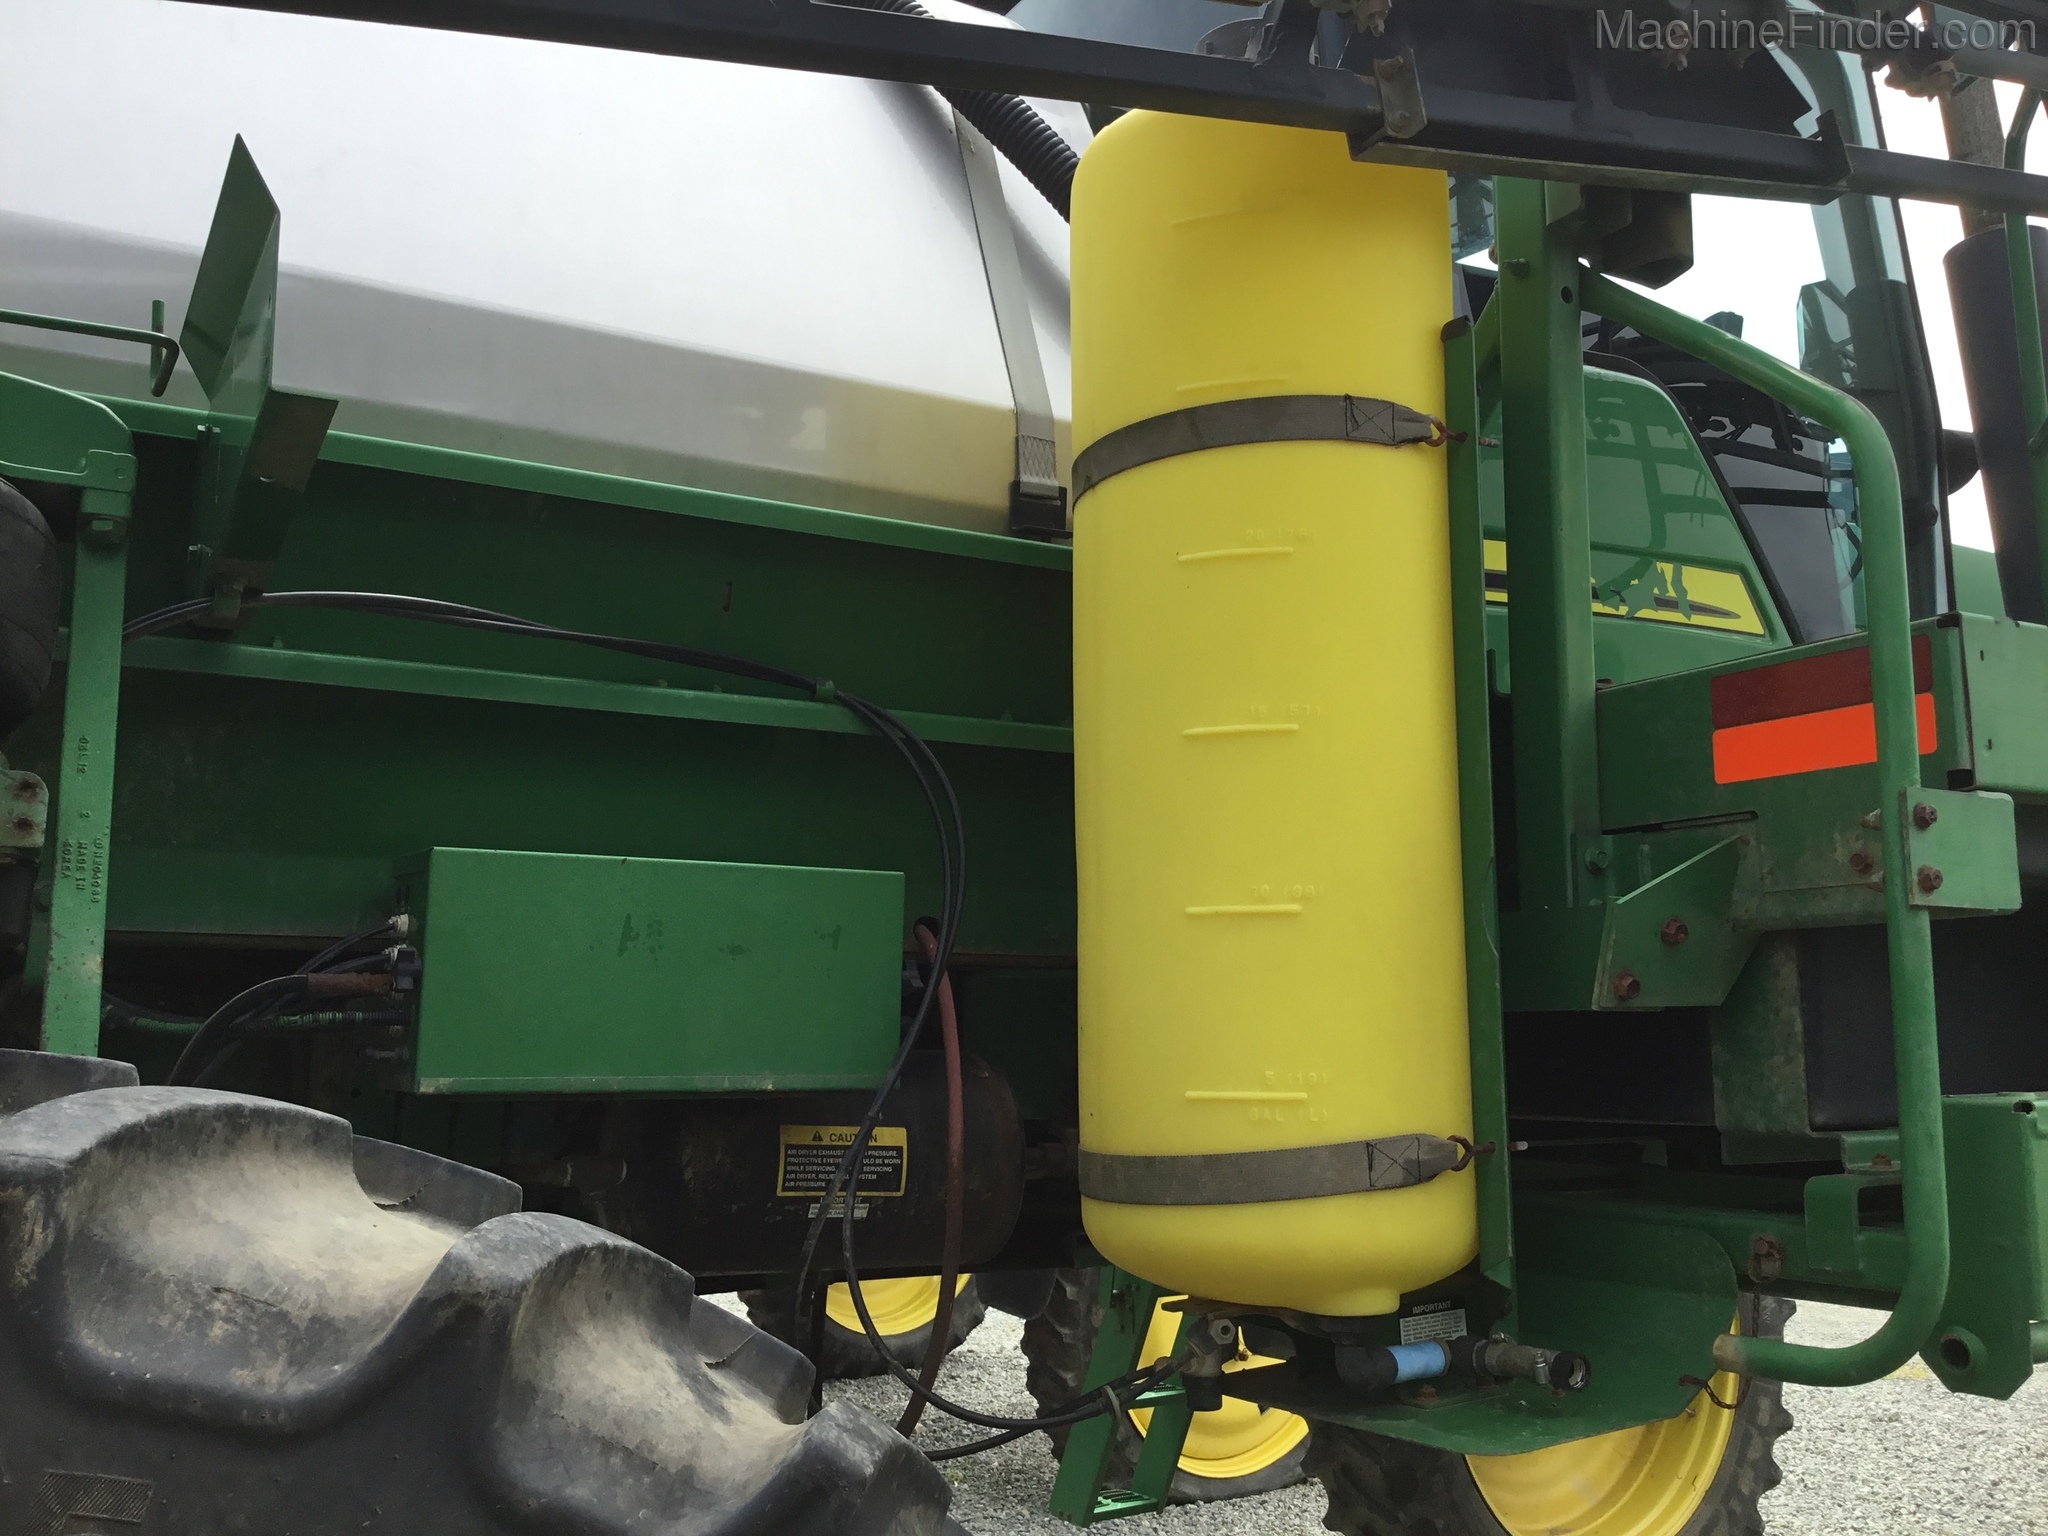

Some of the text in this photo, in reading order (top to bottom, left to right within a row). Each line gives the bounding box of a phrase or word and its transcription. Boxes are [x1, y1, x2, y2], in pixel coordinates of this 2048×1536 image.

[1263, 1069, 1276, 1086] 5
[1248, 1106, 1286, 1123] GAL
[1412, 1301, 1451, 1314] IMPORTANT
